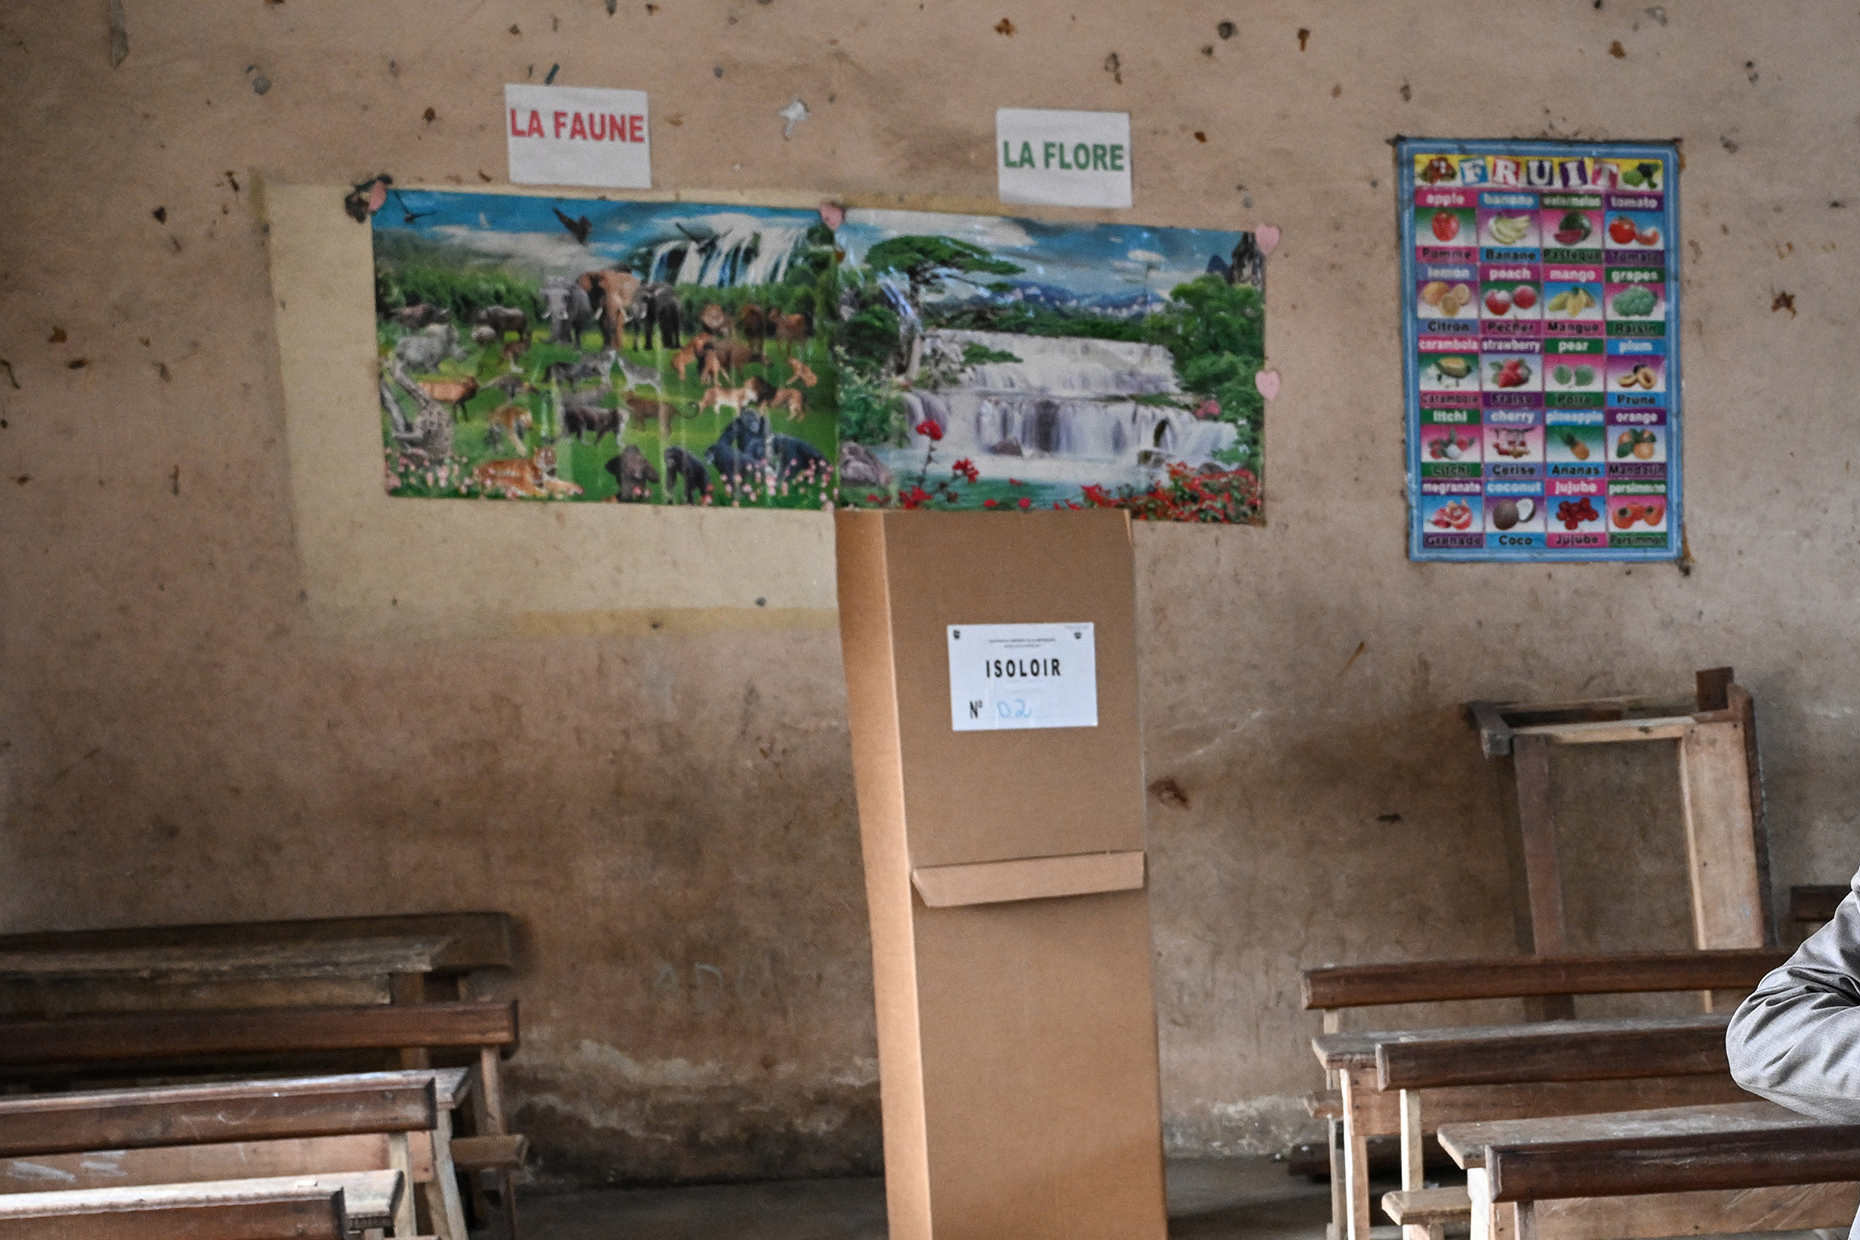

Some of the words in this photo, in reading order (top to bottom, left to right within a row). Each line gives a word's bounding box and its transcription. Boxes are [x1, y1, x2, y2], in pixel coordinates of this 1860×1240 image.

[510, 108, 545, 138] LA
[554, 110, 645, 143] FAUNE
[1003, 140, 1036, 169] LA
[1043, 141, 1125, 172] FLORE
[1460, 158, 1619, 187] FRUIT
[1426, 193, 1465, 206] apple
[1611, 196, 1658, 208] tomato
[1422, 247, 1471, 259] Pomme
[1485, 249, 1536, 260] Banane
[1489, 268, 1531, 282] peach
[1549, 270, 1596, 282] mango
[1611, 271, 1658, 283] grapes
[1427, 321, 1470, 332] Citron
[1548, 322, 1599, 334] Mangue
[1558, 342, 1589, 354] pear
[1617, 394, 1656, 405] Prune
[1491, 410, 1535, 424] cherry
[1615, 412, 1658, 424] orange
[1492, 464, 1535, 475] Cerise
[1552, 465, 1600, 475] Ananas
[1499, 535, 1533, 545] Coco
[985, 658, 1061, 678] ISOLOIR
